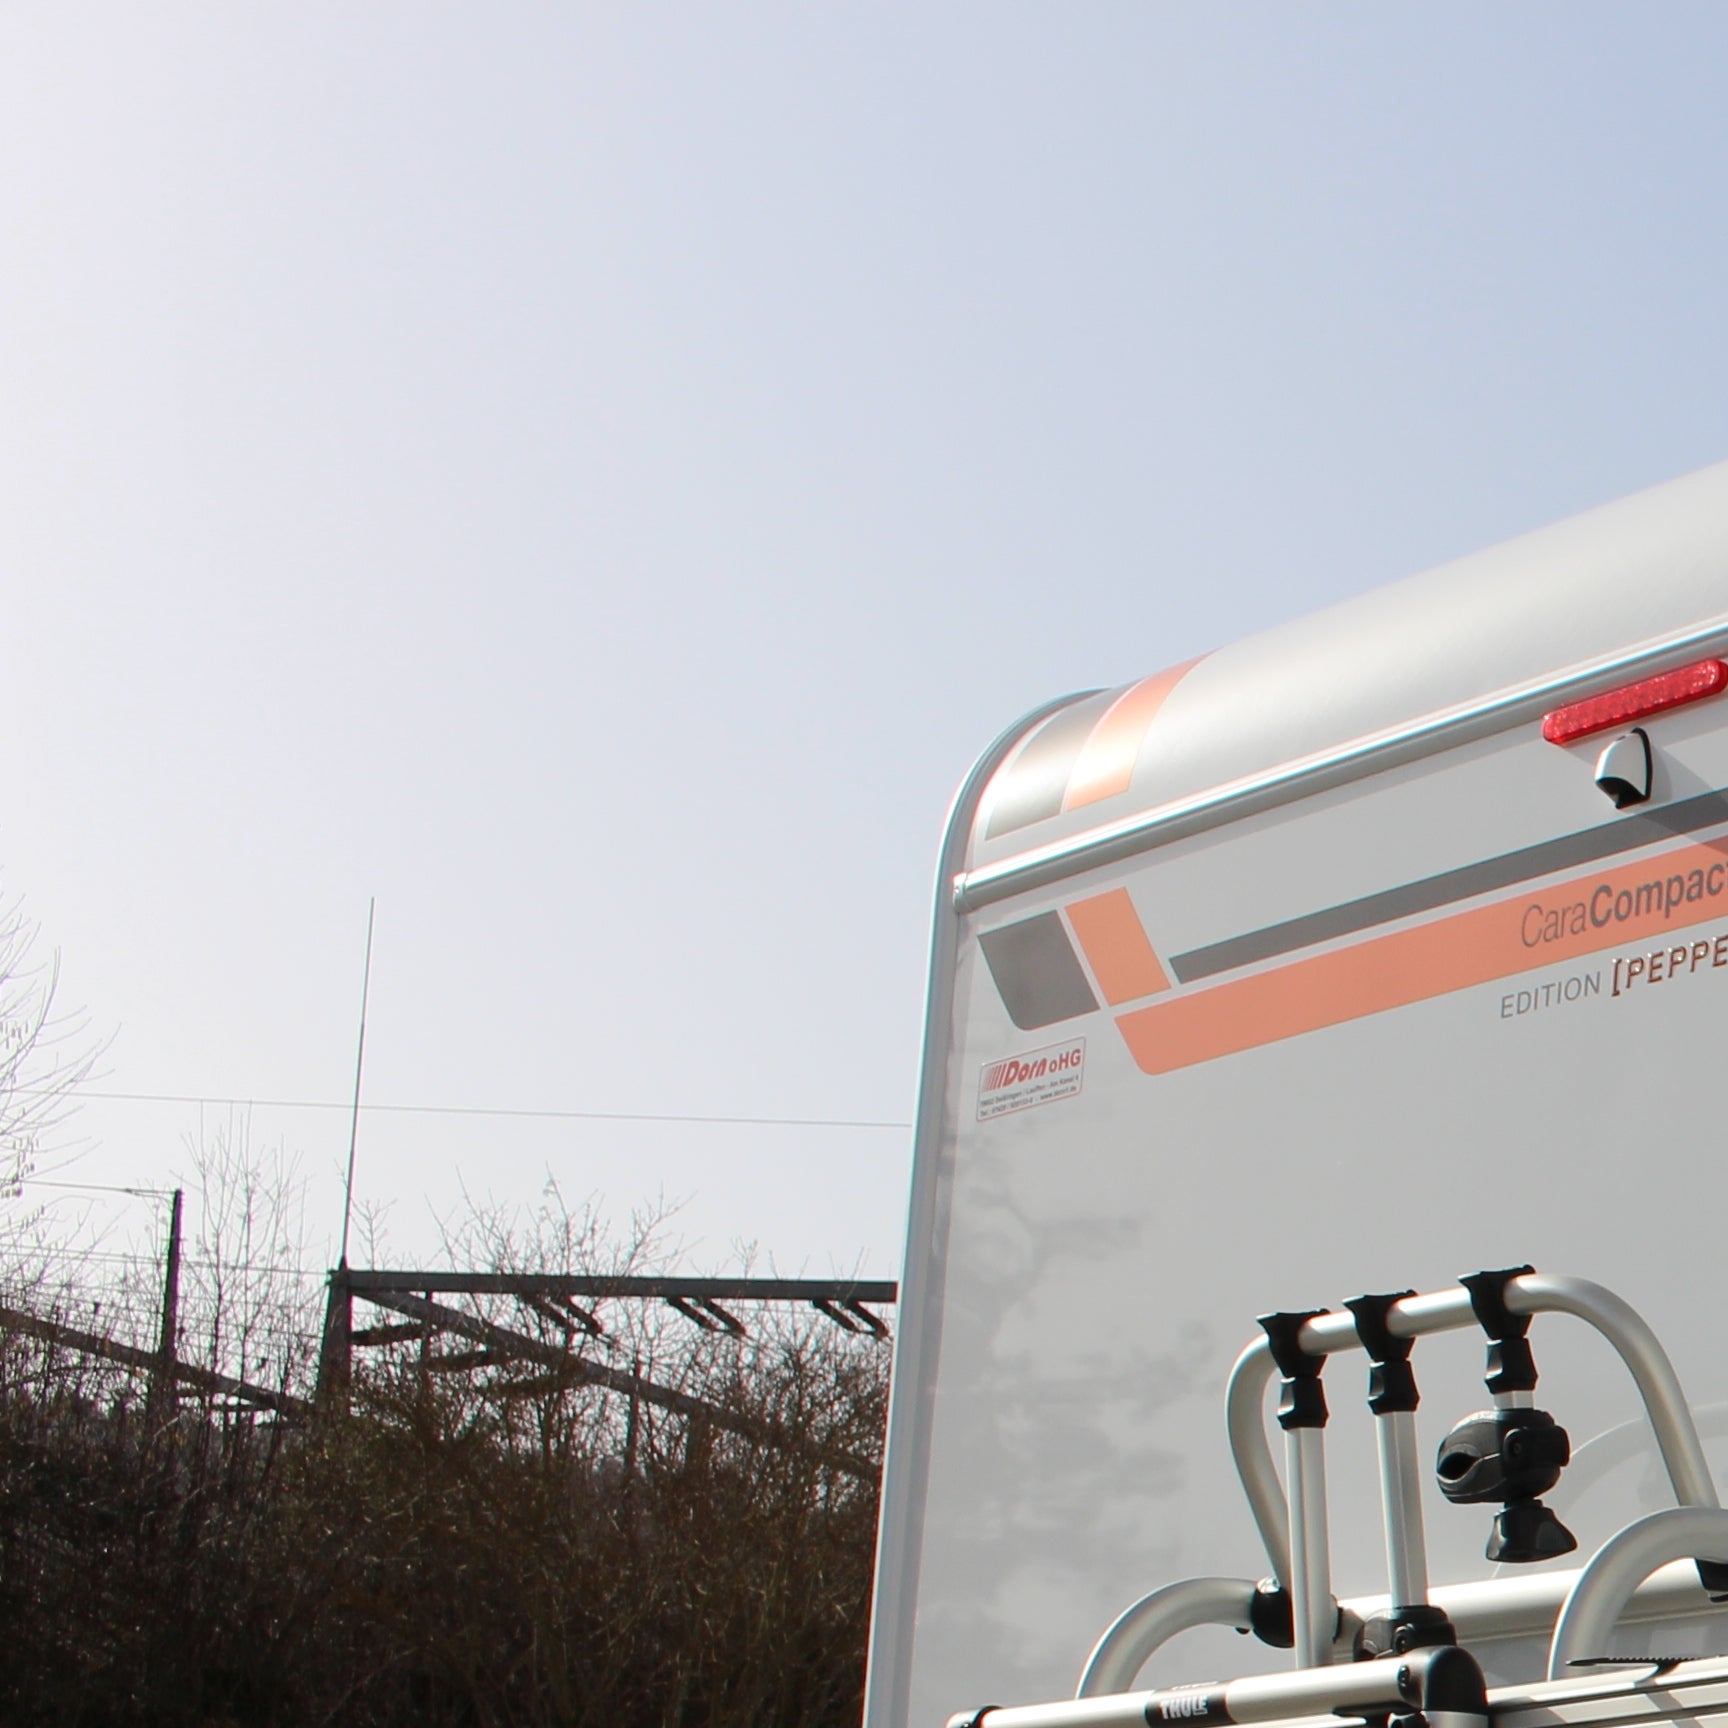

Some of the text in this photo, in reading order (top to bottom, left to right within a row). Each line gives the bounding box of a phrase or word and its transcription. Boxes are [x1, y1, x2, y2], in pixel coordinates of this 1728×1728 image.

[1500, 971, 1602, 1019] EDITION
[1003, 1048, 1081, 1087] Dorn oHG
[1160, 1695, 1208, 1719] THULE
